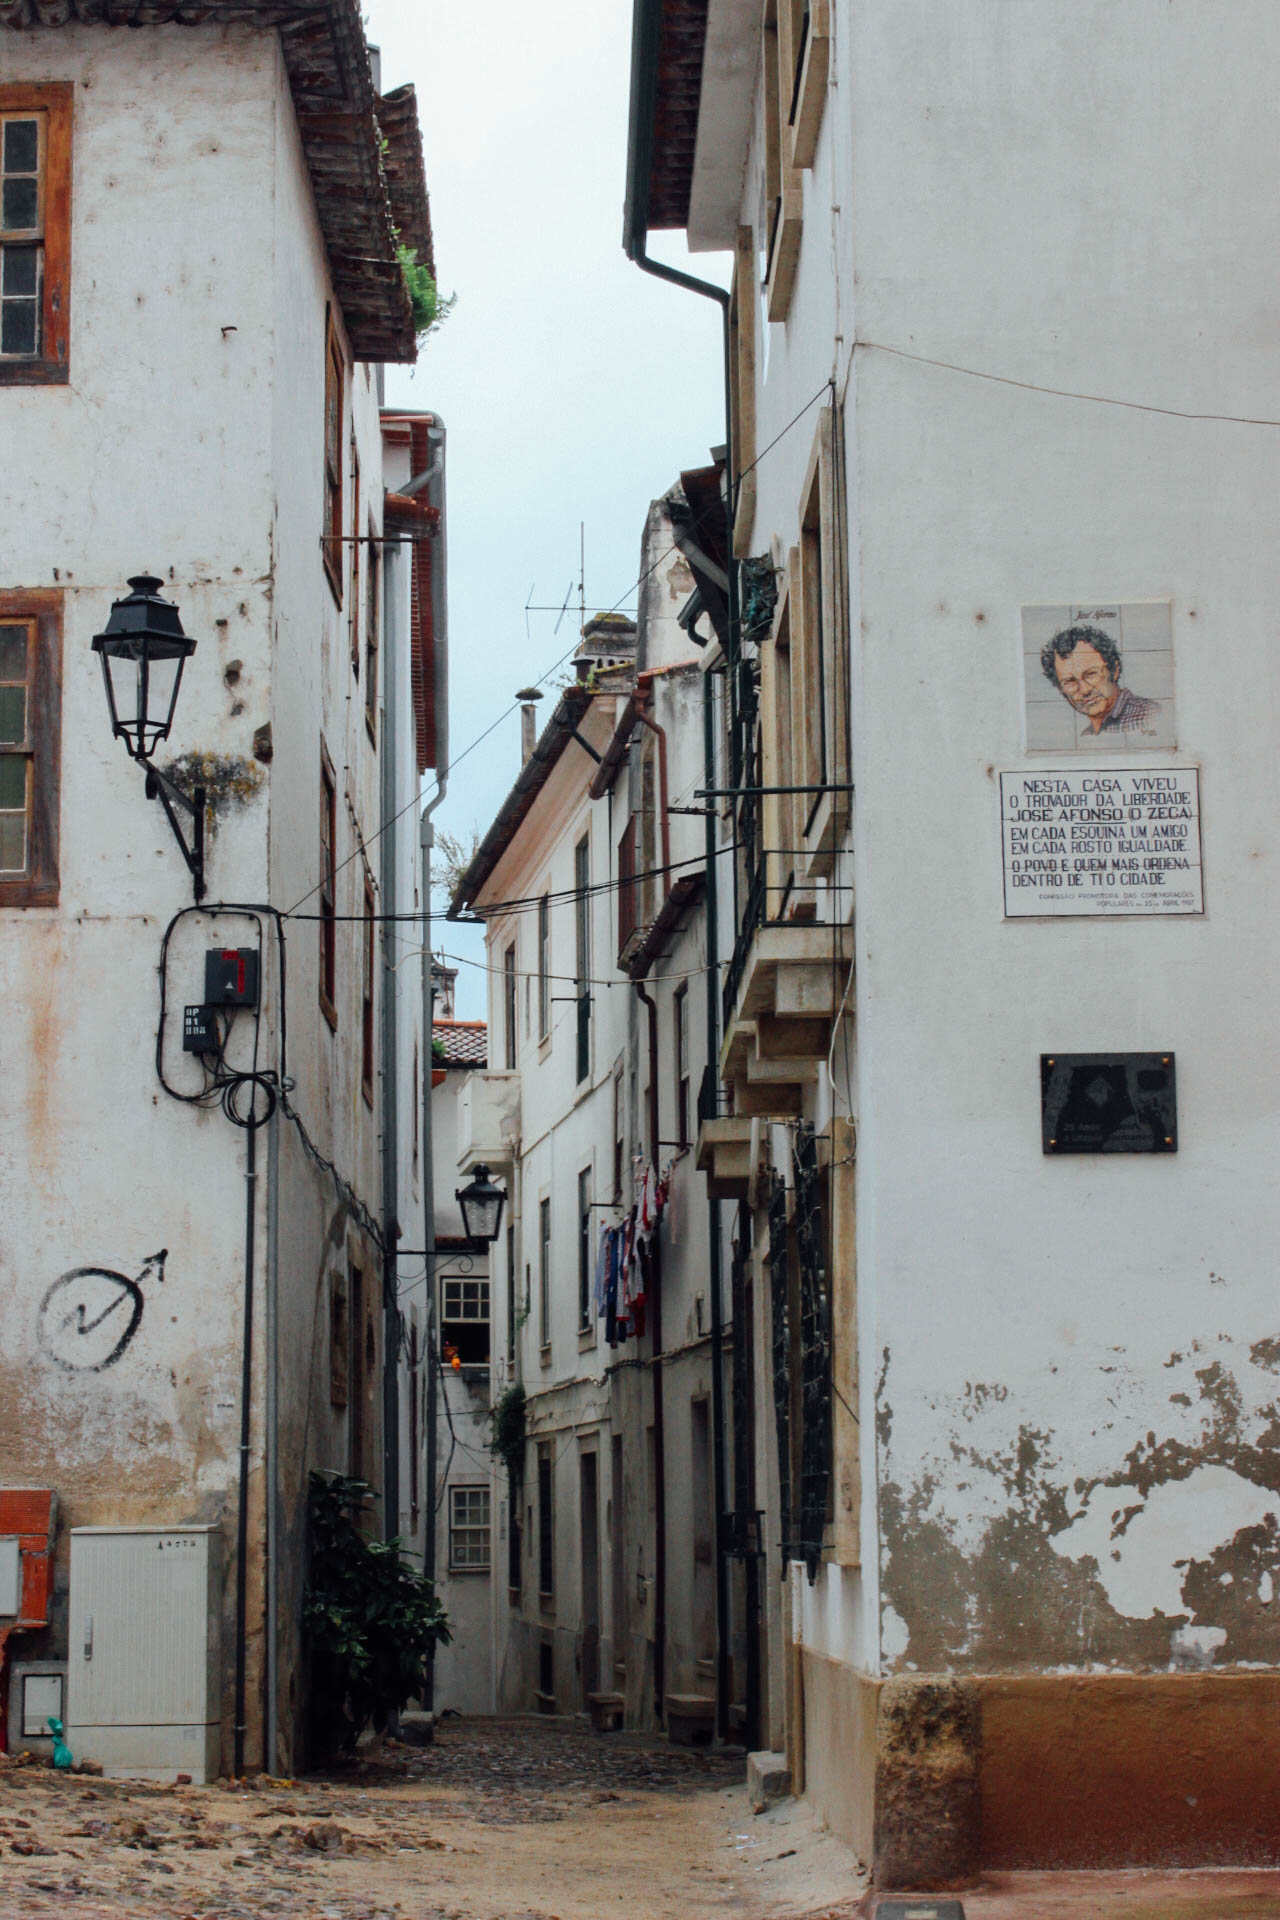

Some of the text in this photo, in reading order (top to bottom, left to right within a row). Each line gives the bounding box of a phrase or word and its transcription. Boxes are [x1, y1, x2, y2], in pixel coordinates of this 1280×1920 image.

[1023, 778, 1177, 793] NESTA CASA VIVEU
[1010, 792, 1191, 808] O TROVADOR DA LIBERDADE
[1011, 808, 1053, 822] JOSÉ
[1058, 809, 1123, 822] AFONSO
[1011, 827, 1028, 841] EM
[1032, 827, 1066, 840] CADA
[1131, 825, 1147, 838] UM
[1153, 824, 1188, 838] AMIGO
[1011, 842, 1029, 855] EM
[1032, 841, 1066, 854] CADA
[1071, 840, 1112, 853] ROSTO
[1012, 860, 1020, 873] O
[1024, 859, 1057, 872] POVO
[1074, 858, 1107, 872] QUEM
[1112, 857, 1139, 871] MAIS
[1143, 857, 1190, 870] ORDENA
[1012, 873, 1063, 887] DENTRO
[1068, 873, 1083, 886] DE
[1089, 873, 1102, 886] TI
[1120, 872, 1166, 886] CIDADE
